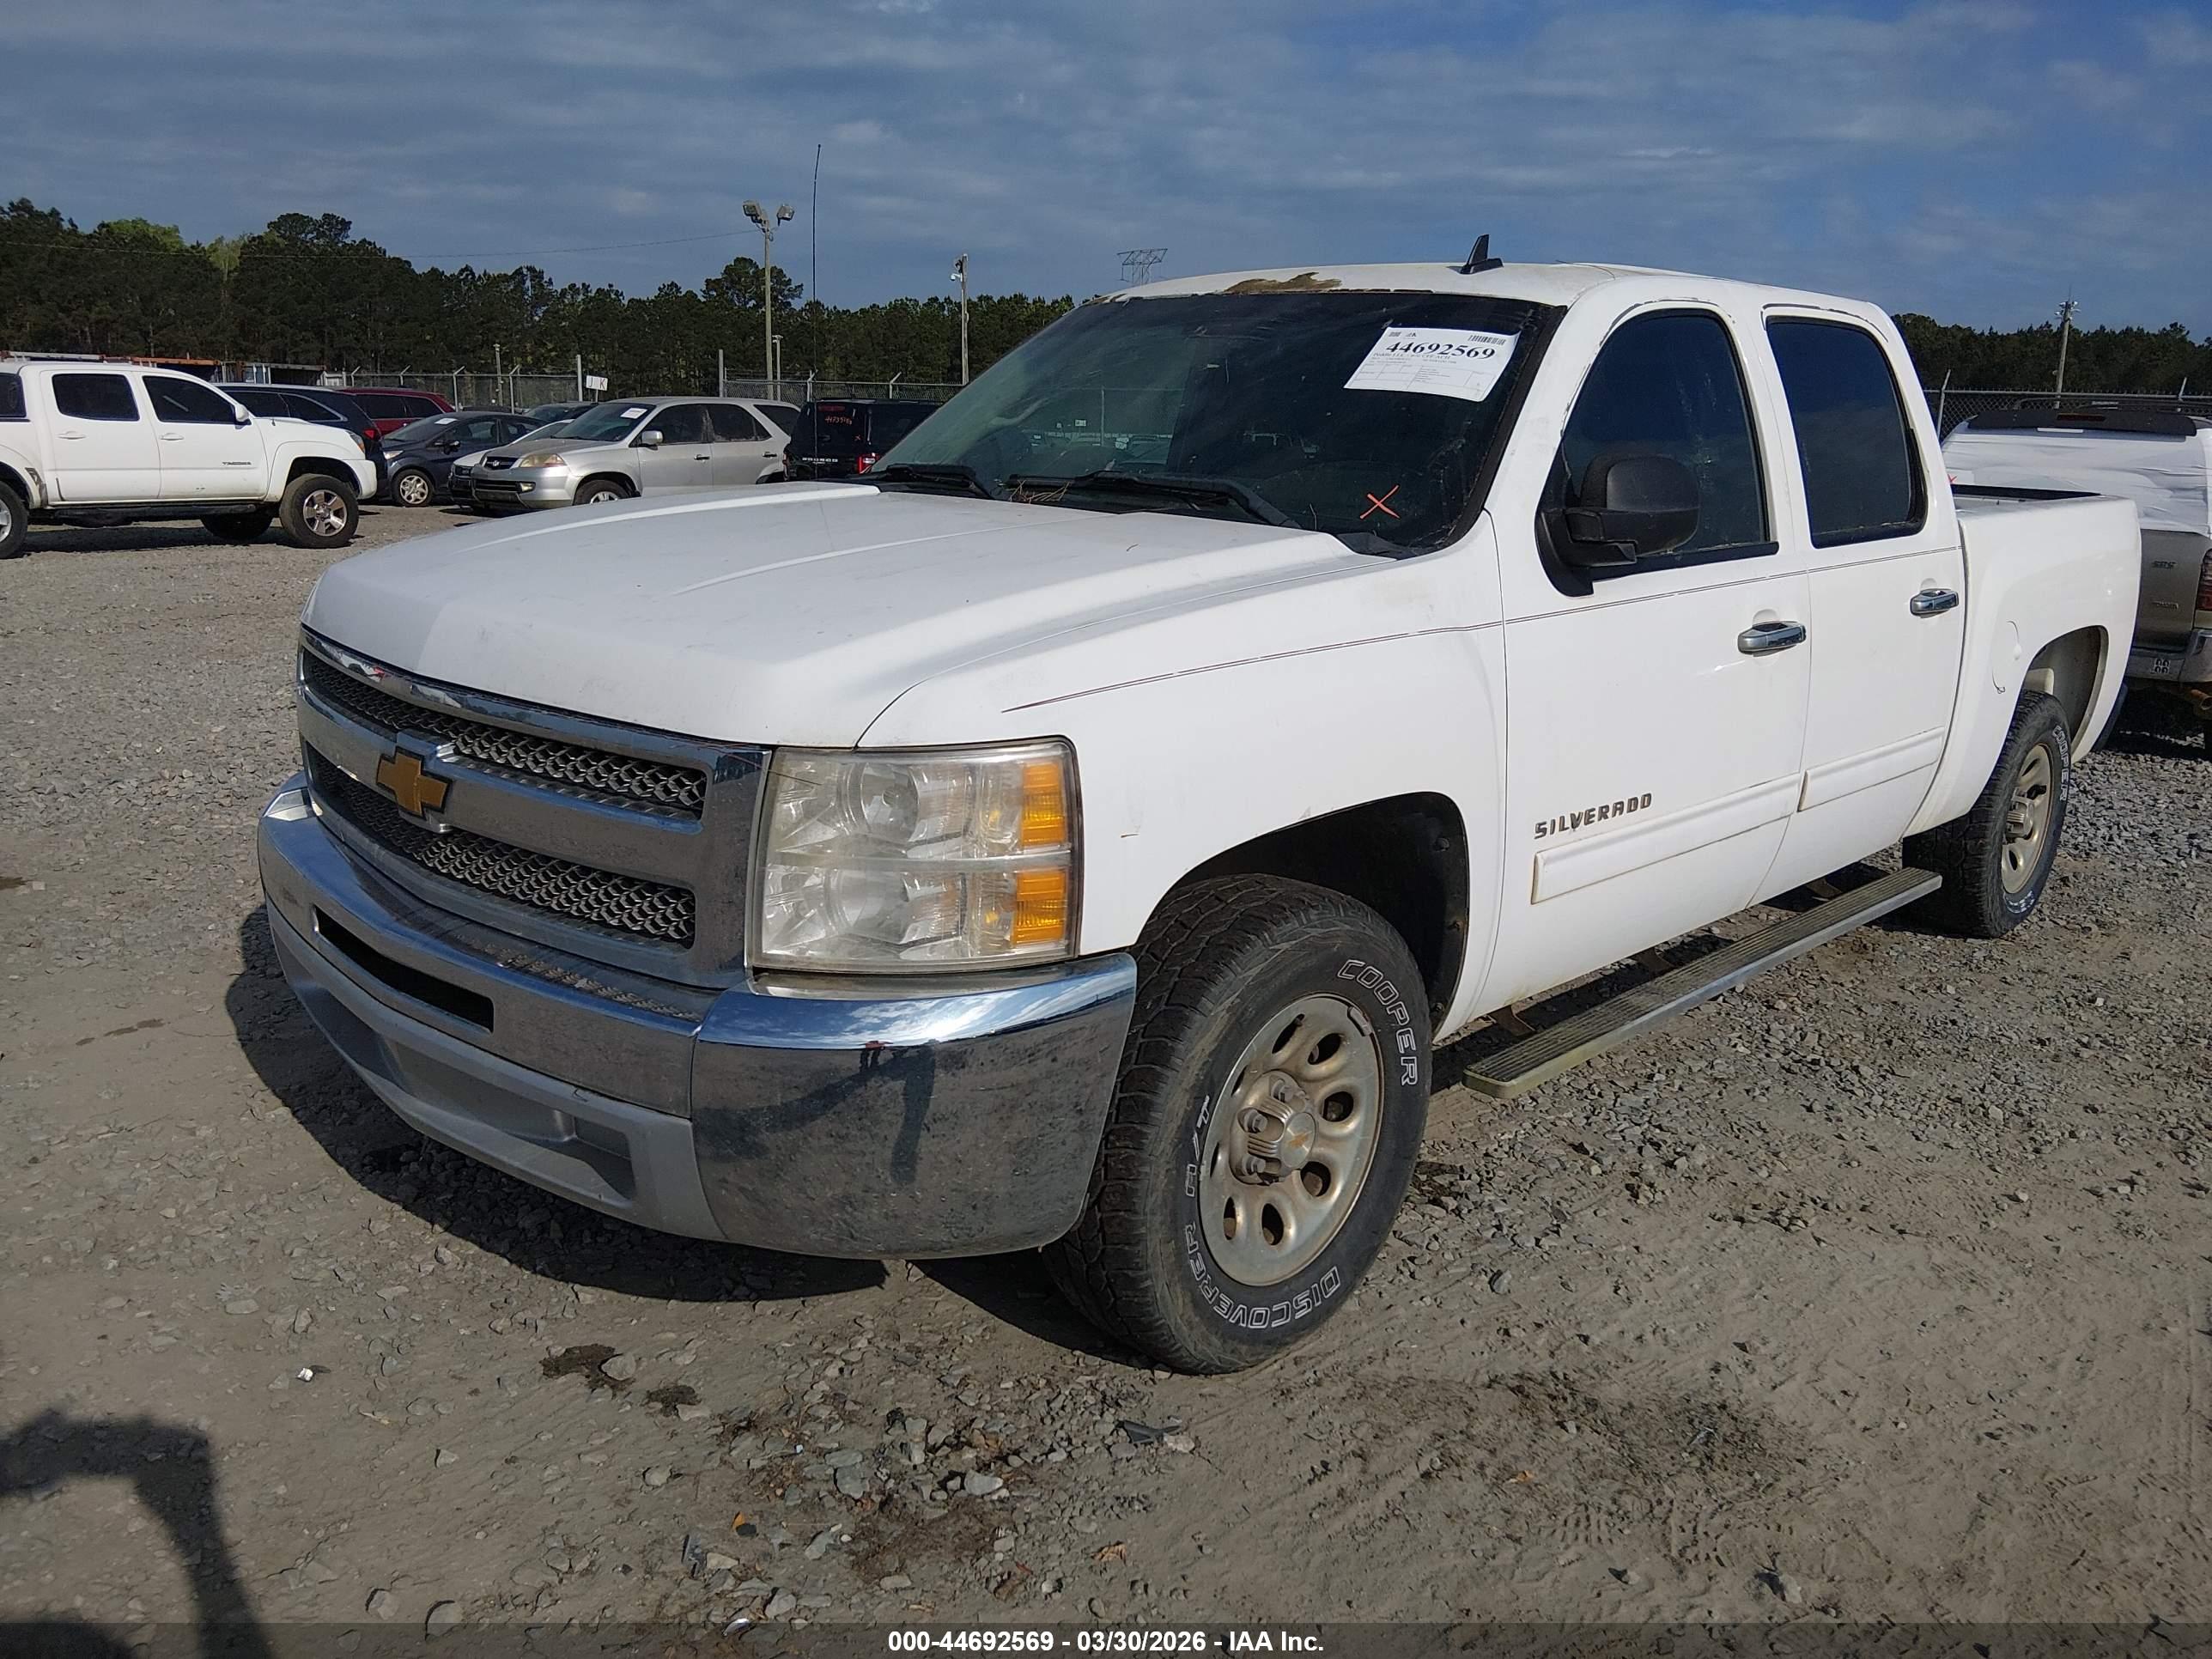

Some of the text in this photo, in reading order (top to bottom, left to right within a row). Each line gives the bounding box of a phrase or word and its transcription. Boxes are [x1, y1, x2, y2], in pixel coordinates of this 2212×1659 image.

[1386, 341, 1496, 360] 44692569
[599, 378, 605, 390] K
[2051, 725, 2069, 803] COOPER
[1534, 793, 1652, 839] SILVERADO
[1337, 958, 1419, 1086] COOPER
[1183, 1224, 1341, 1329] DISCOVERER
